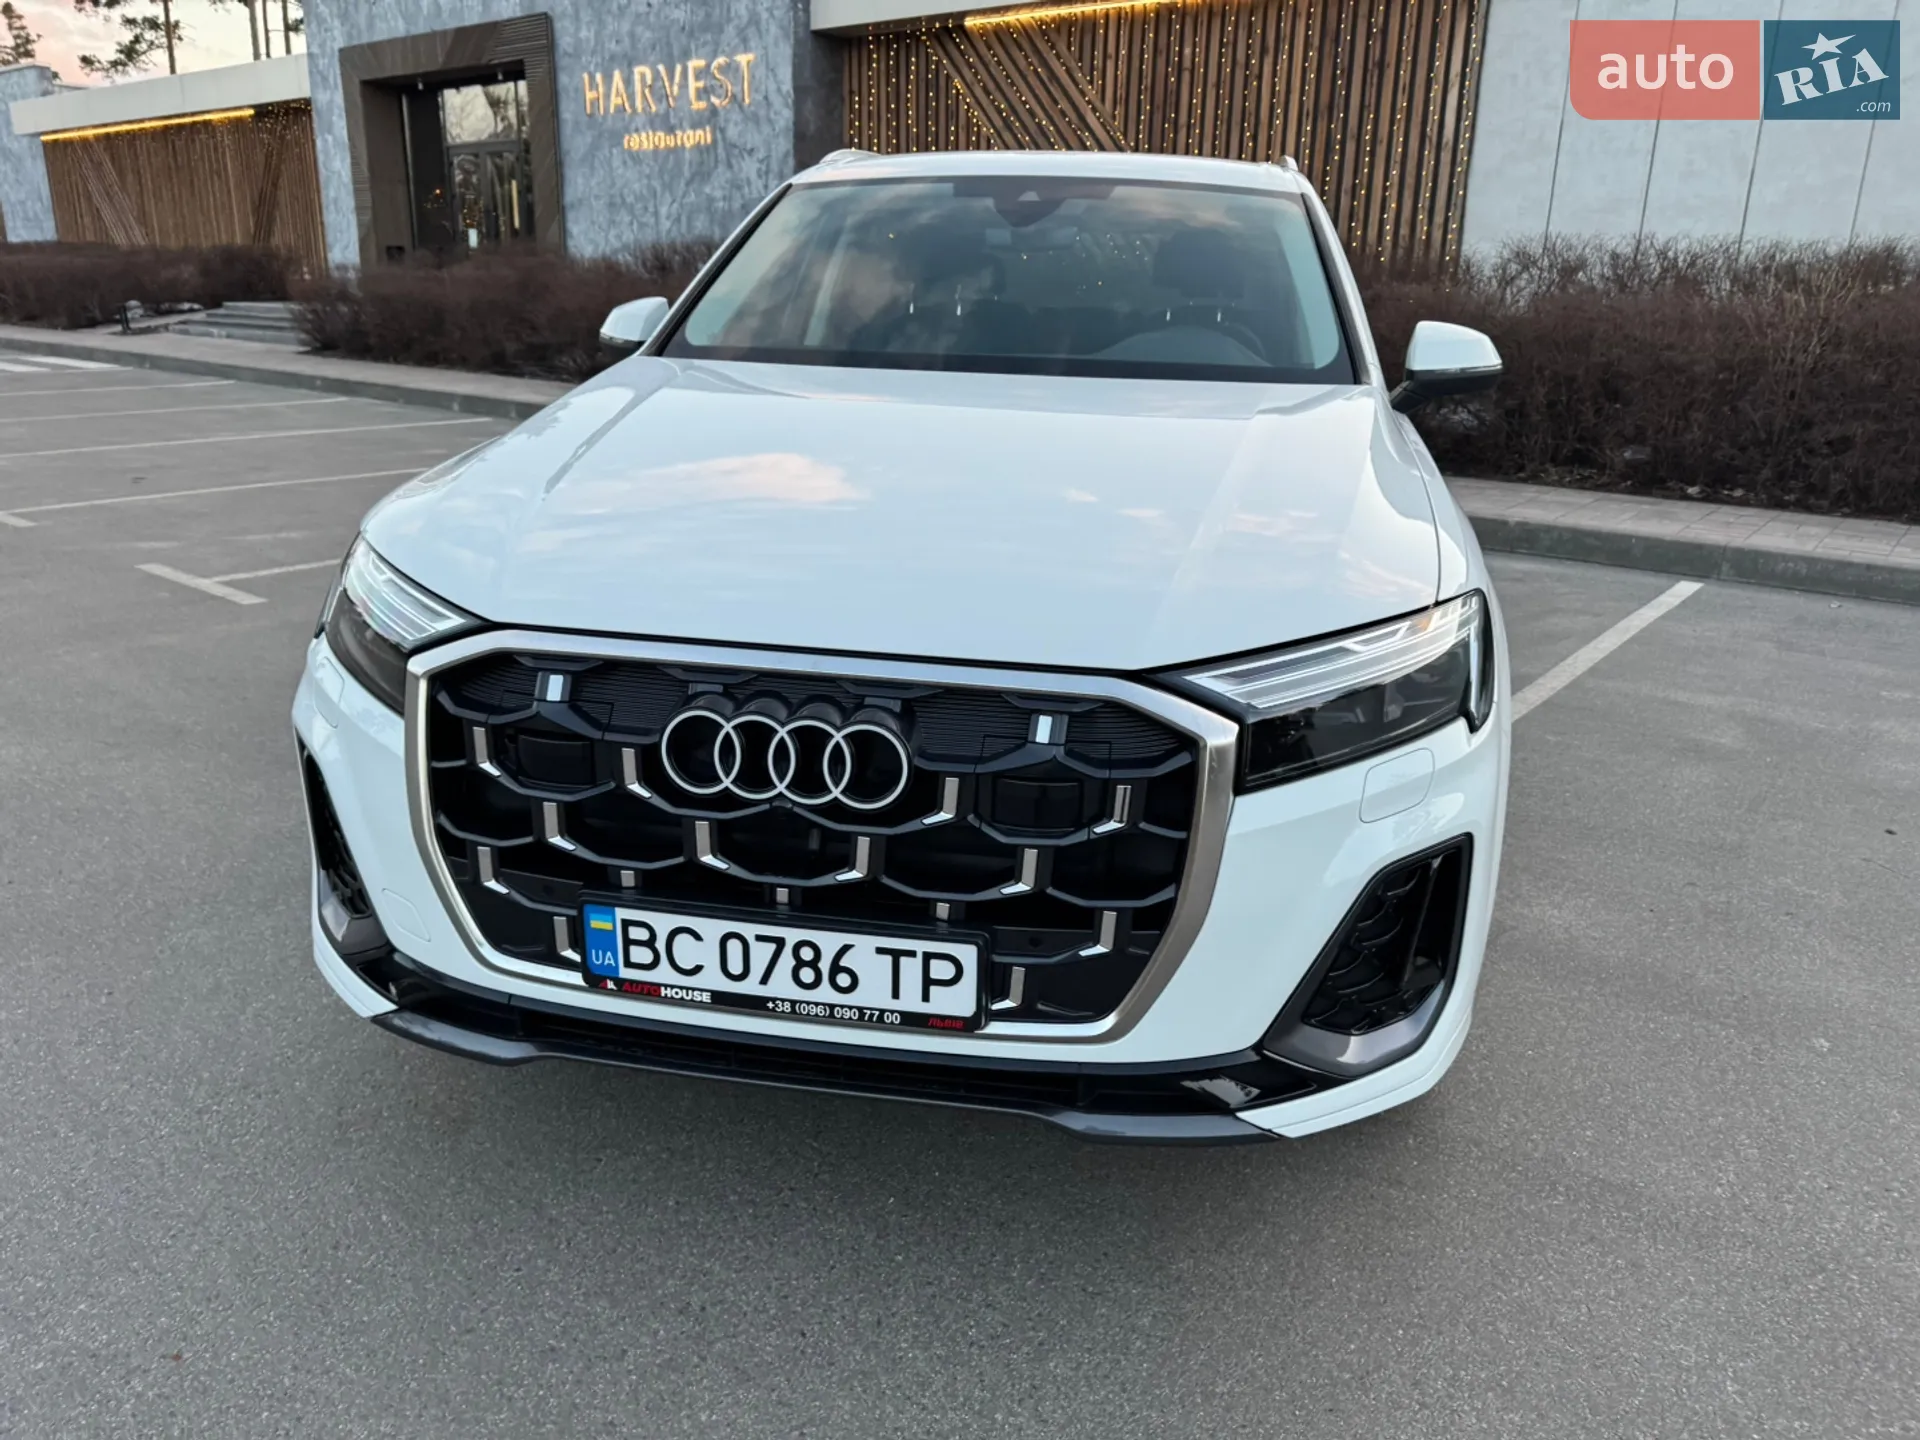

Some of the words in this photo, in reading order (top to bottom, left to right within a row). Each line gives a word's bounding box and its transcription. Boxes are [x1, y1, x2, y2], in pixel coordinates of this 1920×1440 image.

[582, 52, 756, 117] HARVEST
[591, 949, 616, 967] UA
[620, 918, 705, 976] BC
[718, 930, 859, 994] 0786
[875, 947, 964, 1003] TP
[766, 1000, 791, 1013] +38
[795, 1002, 830, 1017] (096)
[834, 1007, 859, 1020] 090
[863, 1009, 880, 1022] 77
[883, 1011, 901, 1024] 00
